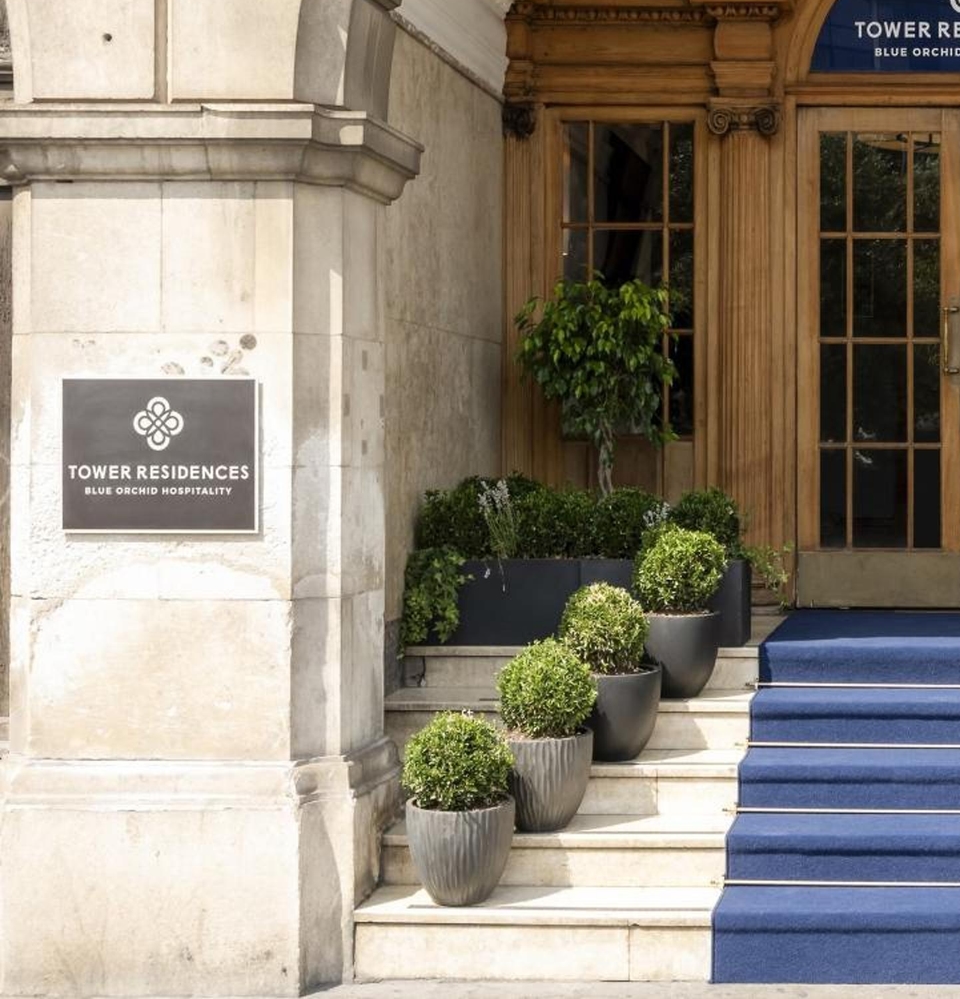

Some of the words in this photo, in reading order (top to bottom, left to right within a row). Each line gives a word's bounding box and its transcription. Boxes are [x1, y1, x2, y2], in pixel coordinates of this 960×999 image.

[855, 21, 931, 38] TOWER
[874, 47, 908, 57] BLUE
[68, 465, 131, 480] TOWER
[137, 465, 249, 480] RESIDENCES
[84, 487, 112, 496] BLUE
[116, 487, 158, 496] ORCHID
[162, 487, 232, 496] HOSPITALITY
